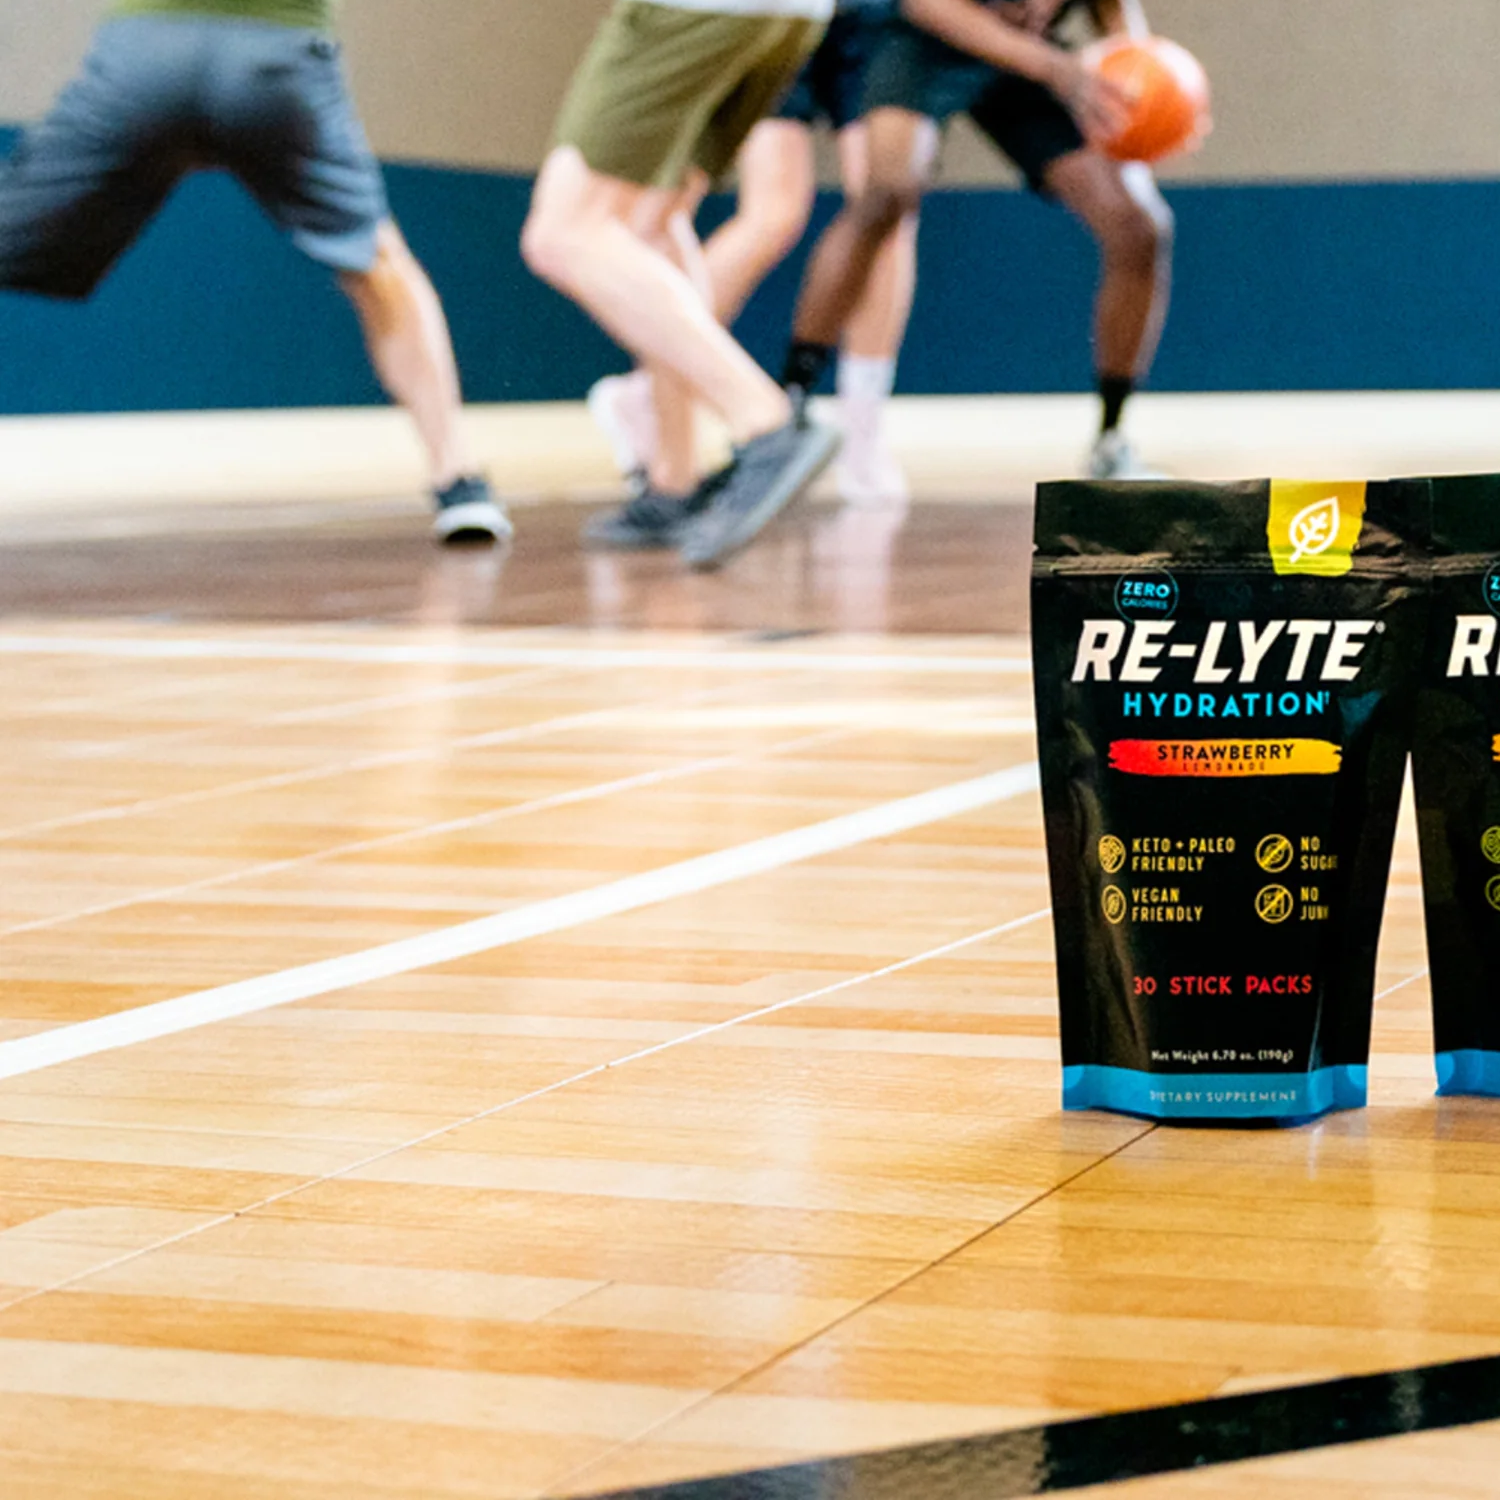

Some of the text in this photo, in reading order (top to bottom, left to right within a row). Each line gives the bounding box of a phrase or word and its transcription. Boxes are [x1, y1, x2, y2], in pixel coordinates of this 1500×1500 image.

[1122, 581, 1170, 598] ZERO
[1158, 744, 1294, 760] STRAWBERRY
[1132, 838, 1170, 853] KETO
[1189, 837, 1236, 853] PALEO
[1300, 836, 1320, 852] NO
[1132, 856, 1204, 872] FRIENDLY
[1132, 888, 1180, 903] VEGAN
[1300, 886, 1319, 902] NO
[1132, 906, 1203, 922] FRIENDLY
[1133, 975, 1312, 994] 30 STICK PACKS
[1151, 1050, 1169, 1061] Net
[1172, 1050, 1209, 1064] Weight
[1212, 1050, 1236, 1061] 6.70
[1258, 1050, 1293, 1064] (190g)
[1150, 1090, 1201, 1102] DIETARY
